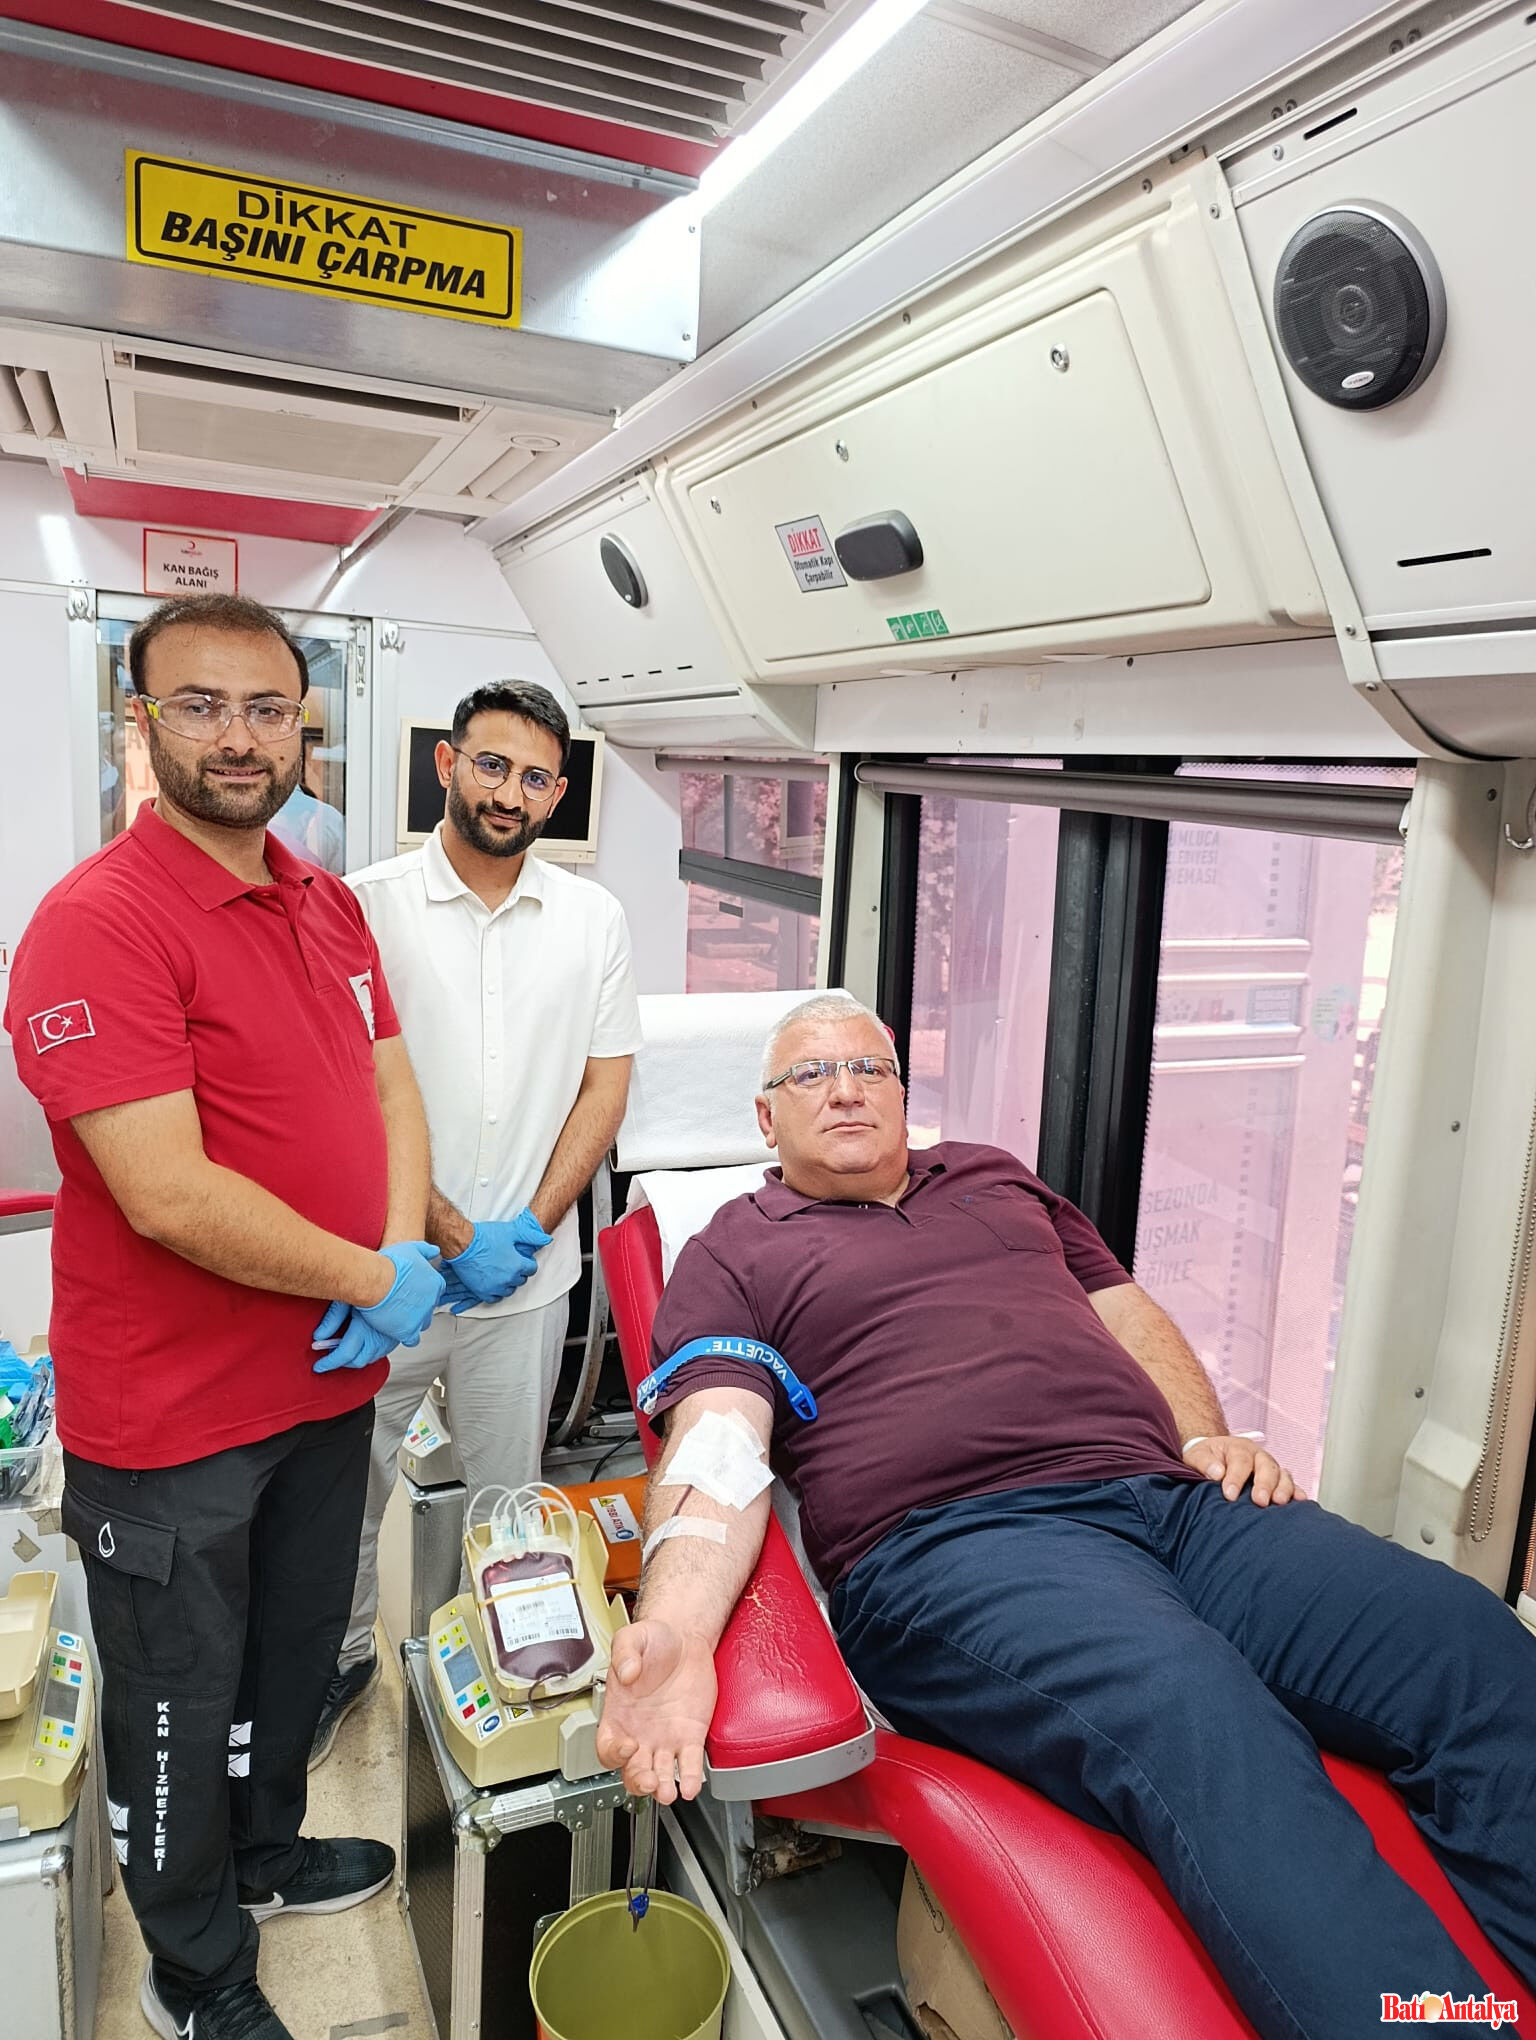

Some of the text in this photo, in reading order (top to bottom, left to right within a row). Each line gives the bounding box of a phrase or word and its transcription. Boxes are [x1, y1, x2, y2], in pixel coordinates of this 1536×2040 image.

[238, 190, 417, 249] DİKKAT
[161, 211, 486, 299] BAŞINI ÇARPMA
[787, 527, 821, 553] DİKKAT
[163, 563, 219, 580] KAN BAĞIŞ
[175, 577, 207, 588] ALANI
[156, 1701, 170, 1737] KAN
[154, 1751, 169, 1872] HİZMETLERİ
